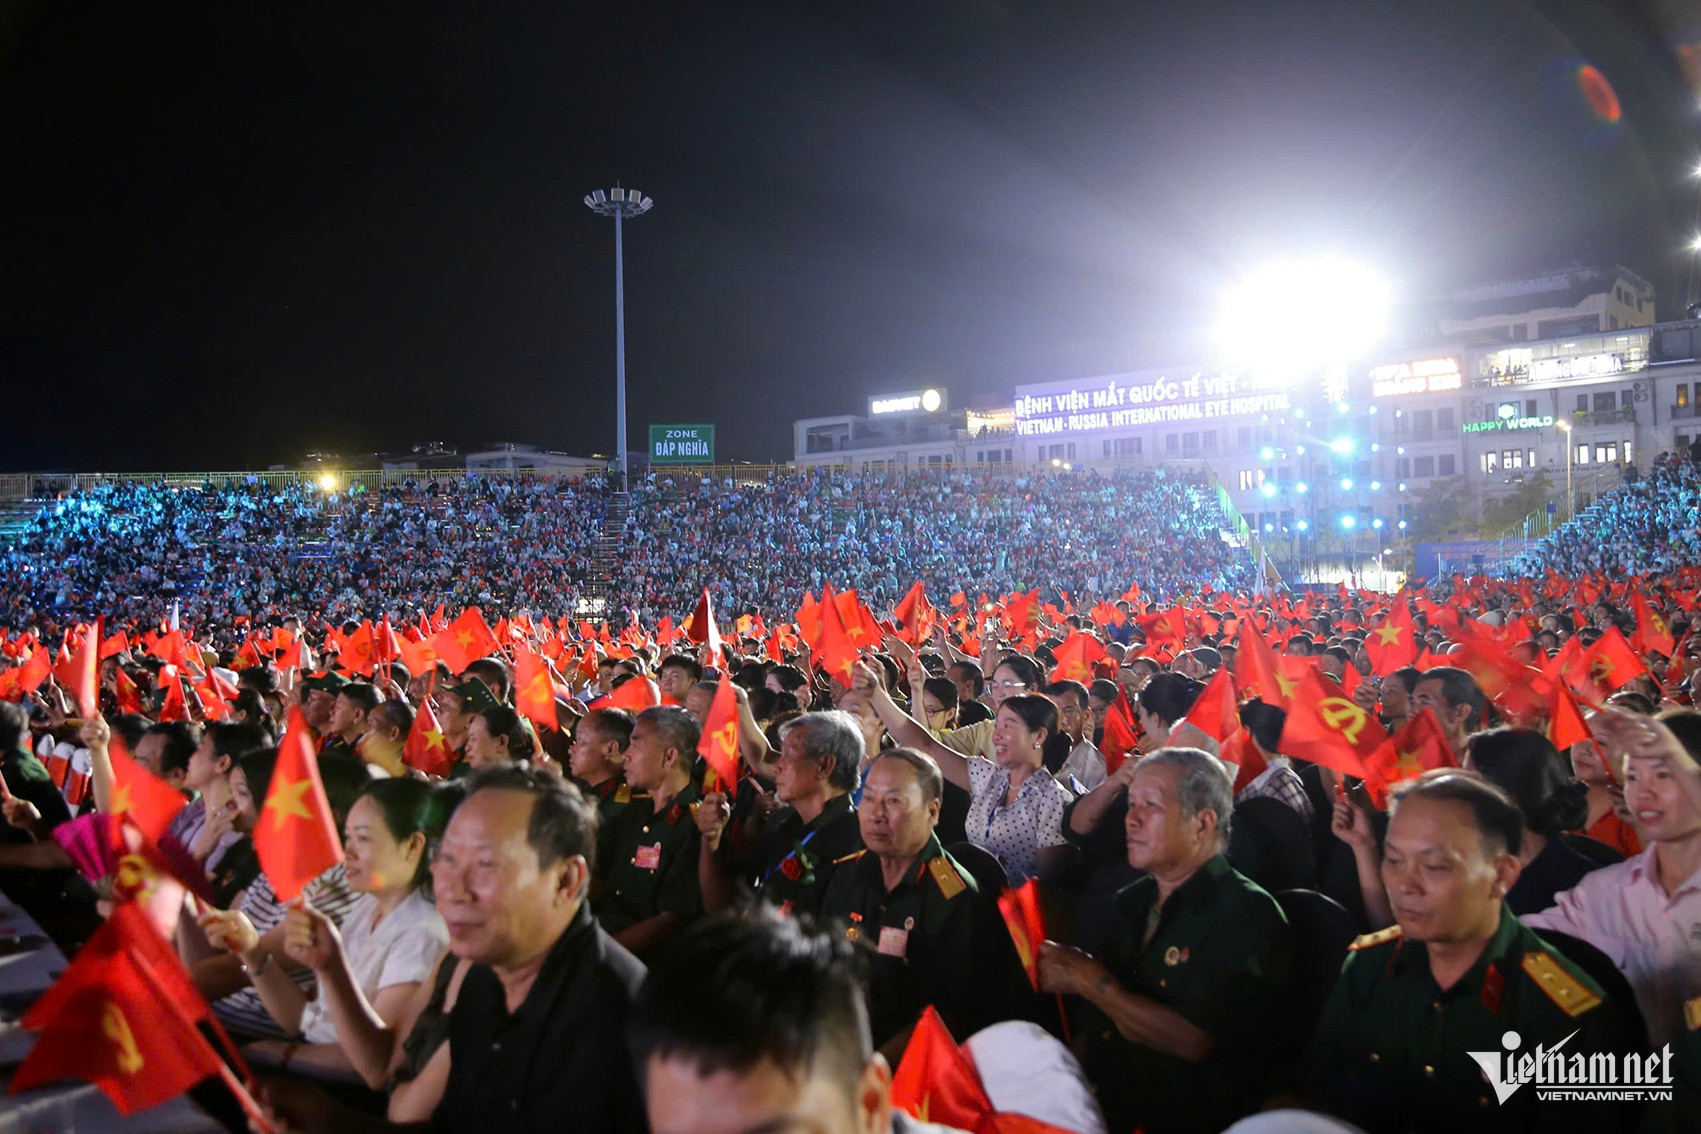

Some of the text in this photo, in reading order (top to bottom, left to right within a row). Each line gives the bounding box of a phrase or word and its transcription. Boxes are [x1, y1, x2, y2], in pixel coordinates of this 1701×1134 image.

[1016, 395, 1052, 419] BỆNH
[1056, 389, 1089, 414] VIỆN
[1093, 381, 1125, 407] MẮT
[1129, 376, 1178, 403] QUỐC
[1182, 371, 1201, 398] TẾ
[1203, 371, 1238, 398] VIỆT
[1112, 402, 1202, 427] INTERNATIONAL
[1205, 399, 1229, 417] EYE
[1230, 392, 1291, 415] HOSPITAL
[1462, 415, 1553, 433] HAPPY WORLD
[665, 429, 698, 438] ZONE
[655, 439, 709, 456] ĐÁP NGHĨA
